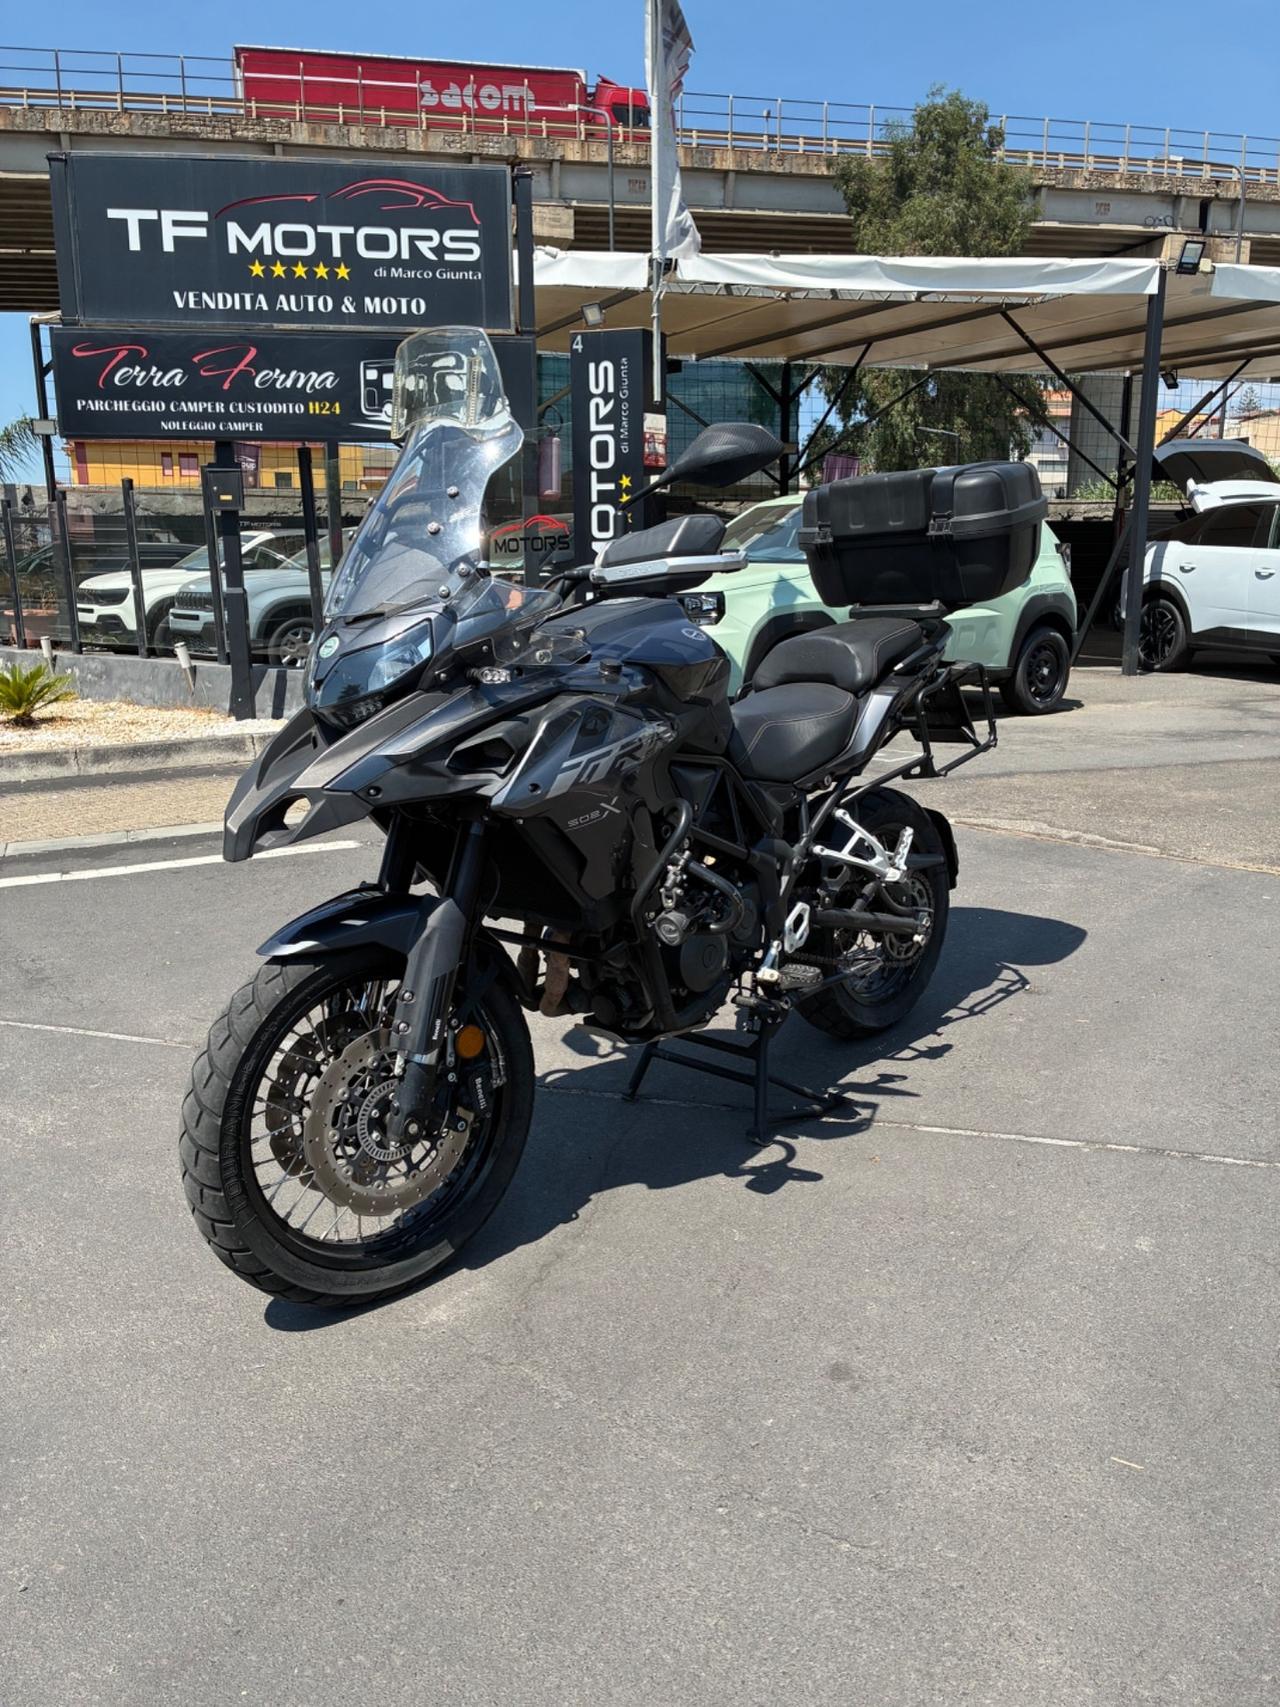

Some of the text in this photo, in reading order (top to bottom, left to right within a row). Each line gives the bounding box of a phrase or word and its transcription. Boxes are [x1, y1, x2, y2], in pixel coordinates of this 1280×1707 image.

[106, 208, 482, 262] TF MOTORS
[374, 265, 482, 281] di Marco Giunta
[173, 290, 426, 316] VENDITA AUTO & MOTO
[572, 334, 584, 353] 4
[72, 342, 340, 394] Terra Ferma
[76, 399, 341, 415] PARCHEGGIO CAMPER CUSTODITO H24
[619, 357, 630, 453] di Marco Giunta
[160, 420, 263, 432] NOLEGGIO CAMPER
[588, 360, 616, 556] OTORS
[494, 534, 570, 554] MOTORS
